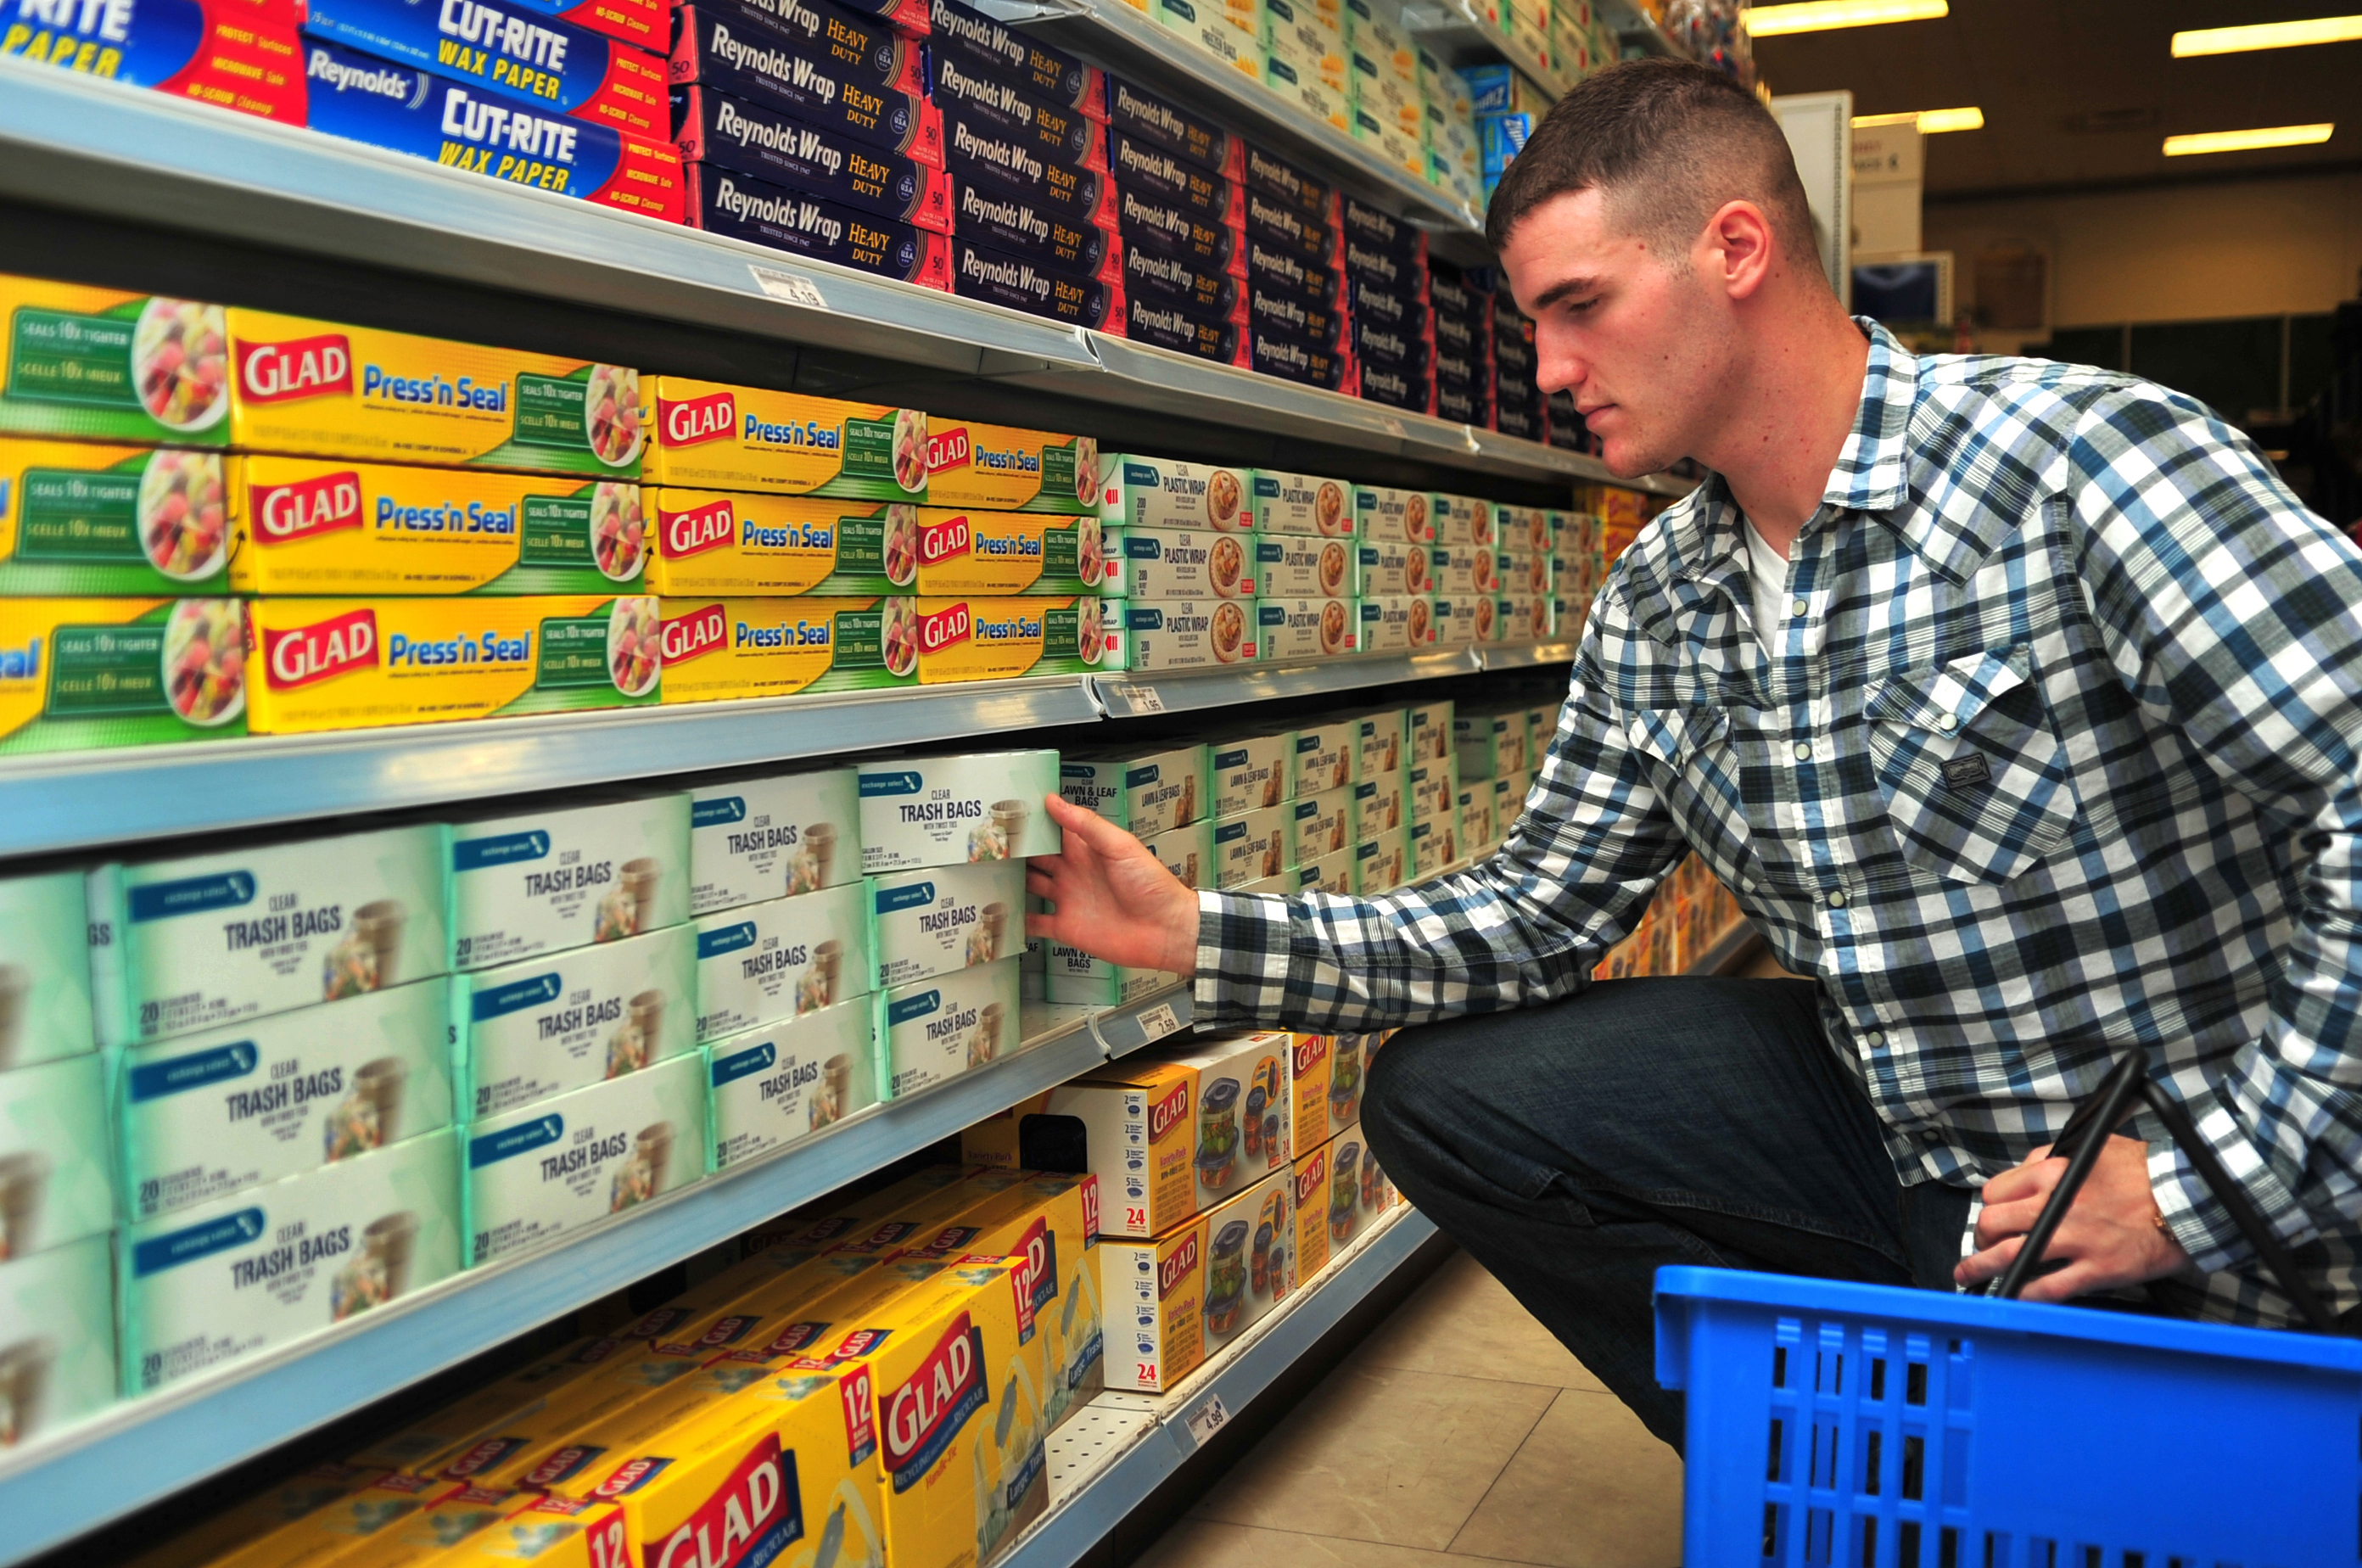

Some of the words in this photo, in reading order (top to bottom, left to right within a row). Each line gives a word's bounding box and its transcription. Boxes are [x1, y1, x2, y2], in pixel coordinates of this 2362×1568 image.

[784, 0, 820, 38] Wrap
[826, 18, 868, 52] HEAVY
[931, 0, 991, 47] Reynolds
[992, 25, 1025, 66] Wrap
[2, 23, 124, 80] PAPER
[215, 24, 254, 44] PROTECT
[257, 36, 293, 56] Surfaces
[439, 0, 568, 73] CUT-RITE
[211, 56, 263, 81] MICROWAVE
[266, 64, 285, 86] Safe
[438, 38, 488, 77] WAX
[491, 59, 561, 101] PAPER
[672, 60, 690, 75] 50
[710, 23, 791, 82] Reynolds
[792, 57, 836, 104] Wrap
[831, 44, 861, 66] DUTY
[1030, 49, 1062, 77] HEAVY
[307, 48, 406, 99] Reynolds
[1033, 70, 1056, 90] DUTY
[187, 82, 234, 105] NO-SCRUB
[237, 94, 273, 116] Cleanup
[842, 83, 884, 115] HEAVY
[941, 59, 999, 99] Reynolds
[1000, 85, 1032, 126] Wrap
[442, 87, 578, 164] CUT-RITE
[847, 109, 877, 130] DUTY
[1037, 108, 1067, 135] HEAVY
[716, 101, 797, 154] Reynolds
[798, 129, 841, 176] Wrap
[954, 121, 1010, 167] Reynolds
[1011, 144, 1042, 183] Wrap
[1040, 130, 1062, 147] DUTY
[437, 141, 490, 176] WAX
[495, 154, 569, 192] PAPER
[848, 154, 890, 183] HEAVY
[1047, 164, 1077, 191] HEAVY
[852, 179, 883, 199] DUTY
[1049, 186, 1072, 204] DUTY
[715, 178, 797, 230] Reynolds
[798, 201, 841, 246] Wrap
[962, 186, 1018, 228] Reynolds
[1019, 205, 1049, 244] Wrap
[1124, 192, 1165, 228] Reynolds
[1166, 210, 1189, 241] Wrap
[848, 223, 890, 251] HEAVY
[1053, 223, 1082, 248] HEAVY
[1055, 244, 1077, 261] DUTY
[852, 248, 883, 266] DUTY
[1128, 246, 1170, 280] Reynolds
[1170, 260, 1193, 292] Wrap
[962, 248, 1019, 288] Reynolds
[1020, 266, 1050, 301] Wrap
[1055, 280, 1084, 304] HEAVY
[1057, 301, 1079, 316] DUTY
[1133, 300, 1172, 332] Reynolds
[1173, 313, 1195, 342] Wrap
[244, 345, 348, 396] GLAD
[456, 377, 507, 413] Seal
[523, 384, 542, 396] SEALS
[558, 389, 584, 401] TIGHTER
[668, 402, 734, 441] GLAD
[806, 422, 840, 450] Seal
[926, 436, 968, 469] GLAD
[1017, 451, 1040, 472] Seal
[1163, 476, 1187, 495] PLASTIC
[1188, 479, 1206, 496] WRAP
[261, 484, 358, 536] GLAD
[467, 501, 517, 535] Seal
[669, 510, 731, 552] GLAD
[802, 523, 833, 549] Seal
[924, 524, 968, 559] GLAD
[1018, 534, 1041, 556] Seal
[1164, 547, 1188, 564] PLASTIC
[1188, 549, 1206, 565] WRAP
[660, 613, 724, 659] GLAD
[798, 619, 831, 645] Seal
[924, 610, 968, 648] GLAD
[1018, 617, 1042, 637] Seal
[1167, 617, 1190, 633] PLASTIC
[1191, 616, 1209, 632] WRAP
[272, 621, 374, 681] GLAD
[481, 630, 531, 663] Seal
[932, 789, 950, 800] CLEAR
[1061, 787, 1085, 796] LAWN
[1087, 787, 1094, 796] &
[1096, 787, 1117, 798] LEAF
[1075, 796, 1099, 806] BAGS
[899, 804, 943, 823] TRASH
[947, 800, 982, 819] BAGS
[728, 832, 765, 854] TRASH
[767, 826, 797, 848] BAGS
[525, 868, 571, 897] TRASH
[575, 861, 612, 888] BAGS
[223, 915, 287, 951] TRASH
[292, 904, 342, 938] BAGS
[920, 911, 949, 933] TRASH
[951, 905, 976, 927] BAGS
[742, 955, 773, 979] TRASH
[775, 945, 806, 970] BAGS
[1053, 946, 1077, 959] LAWN
[1079, 949, 1086, 959] &
[1067, 958, 1091, 969] BAGS
[537, 1010, 581, 1040] TRASH
[586, 997, 621, 1028] BAGS
[926, 1020, 954, 1041] TRASH
[955, 1009, 977, 1032] BAGS
[1158, 1018, 1176, 1033] 2.59
[1297, 1034, 1325, 1071] GLAD
[225, 1084, 288, 1123] TRASH
[293, 1067, 343, 1104] BAGS
[759, 1074, 791, 1101] TRASH
[792, 1061, 817, 1088] BAGS
[1153, 1089, 1186, 1134] GLAD
[540, 1150, 586, 1183] TRASH
[590, 1133, 626, 1164] BAGS
[1299, 1160, 1324, 1198] GLAD
[1083, 1184, 1098, 1221] 12
[1126, 1207, 1145, 1224] 24
[231, 1248, 294, 1290] TRASH
[299, 1226, 350, 1265] BAGS
[1162, 1240, 1196, 1290] GLAD
[1014, 1268, 1033, 1313] 12
[834, 1330, 874, 1358] GLAD
[1137, 1363, 1156, 1381] 24
[845, 1375, 871, 1428] 12
[888, 1335, 971, 1456] GLAD
[1206, 1409, 1223, 1430] 4.99
[595, 1459, 652, 1496] GLAD
[657, 1460, 780, 1568] GLAD
[592, 1520, 624, 1568] 12
